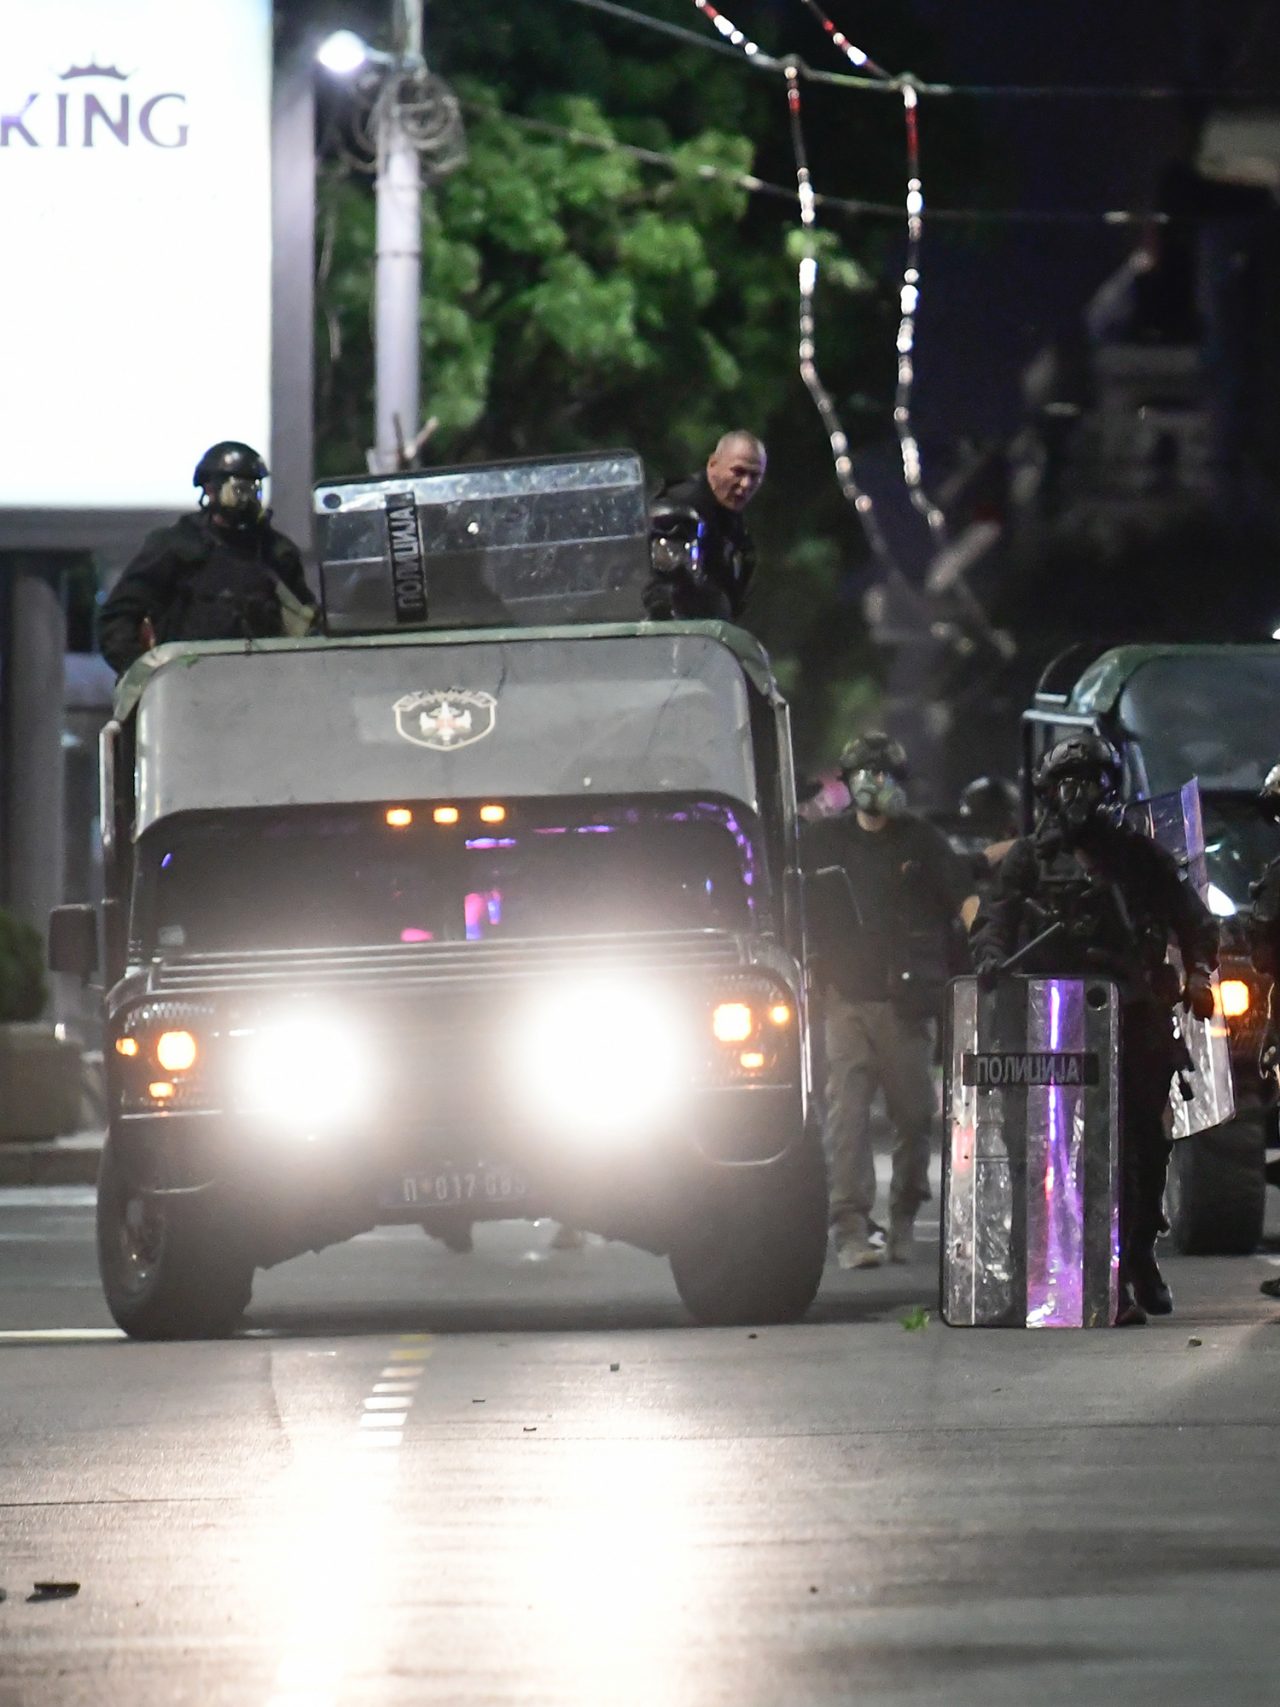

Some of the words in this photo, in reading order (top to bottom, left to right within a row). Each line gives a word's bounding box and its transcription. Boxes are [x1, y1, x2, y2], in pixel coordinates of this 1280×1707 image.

[0, 93, 188, 148] KING
[389, 506, 424, 608] ПОЛИЦИЈА
[976, 1056, 1080, 1084] ПОЛИЦИЈА
